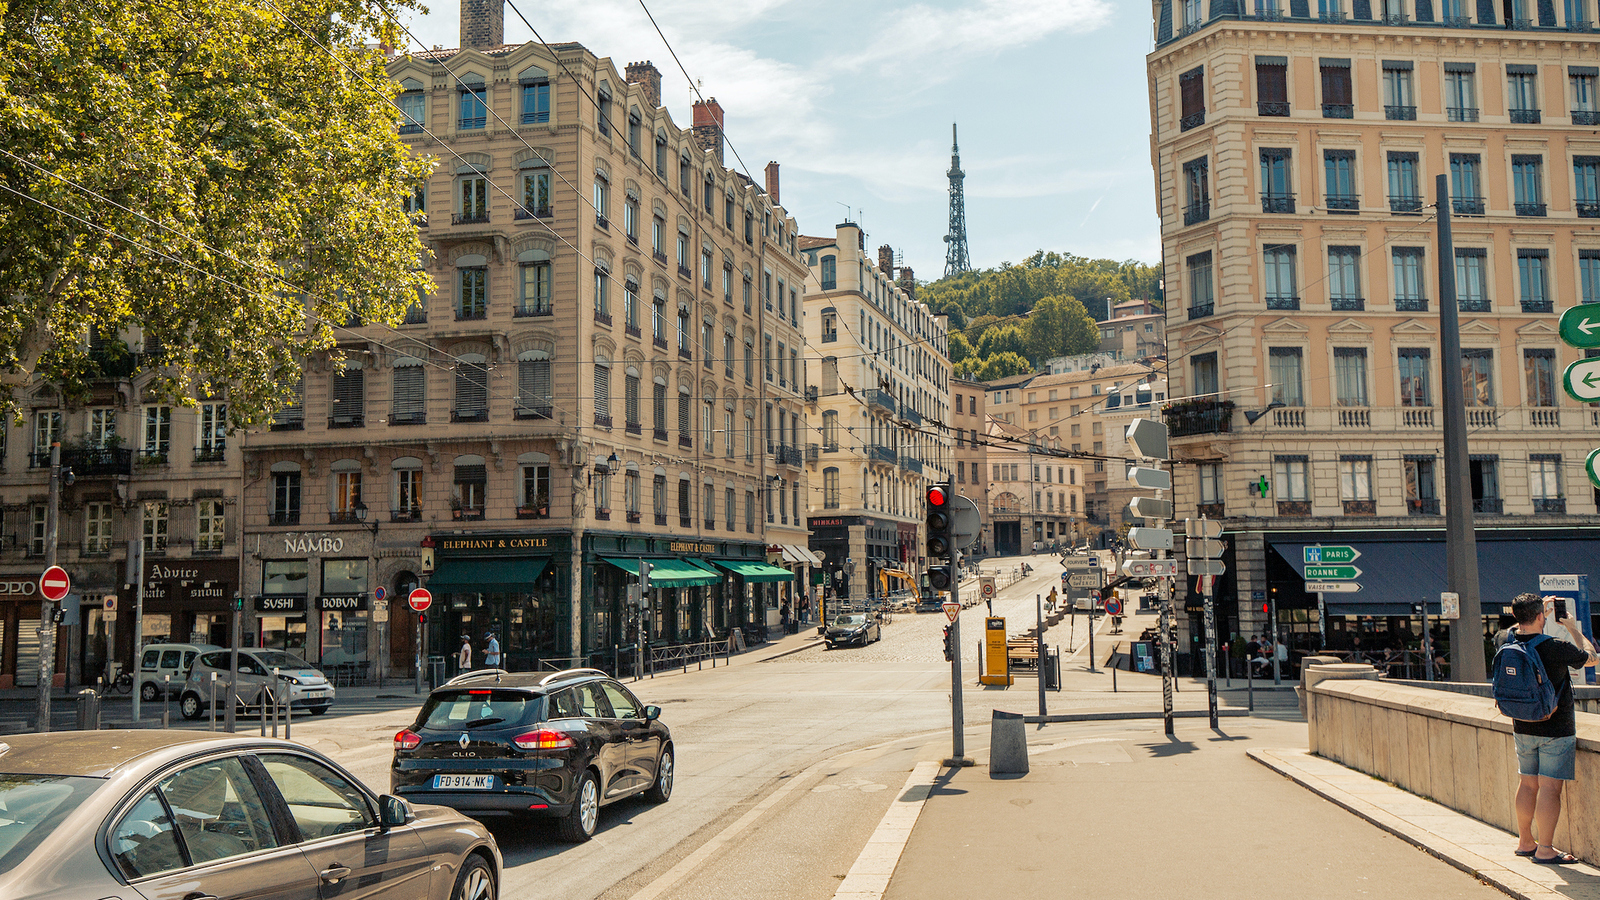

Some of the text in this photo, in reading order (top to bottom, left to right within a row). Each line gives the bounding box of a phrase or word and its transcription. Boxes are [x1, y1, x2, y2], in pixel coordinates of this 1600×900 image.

[284, 537, 344, 553] NAMBO
[443, 538, 548, 549] ELEPHANT & CASTLE
[670, 542, 714, 552] ELEPHANT & CASTLE
[149, 564, 199, 579] Advice
[136, 586, 166, 598] kate
[190, 588, 223, 598] snow
[263, 598, 294, 609] SUSHI
[322, 597, 358, 608] BOBUN
[440, 776, 486, 787] FD-914-NK
